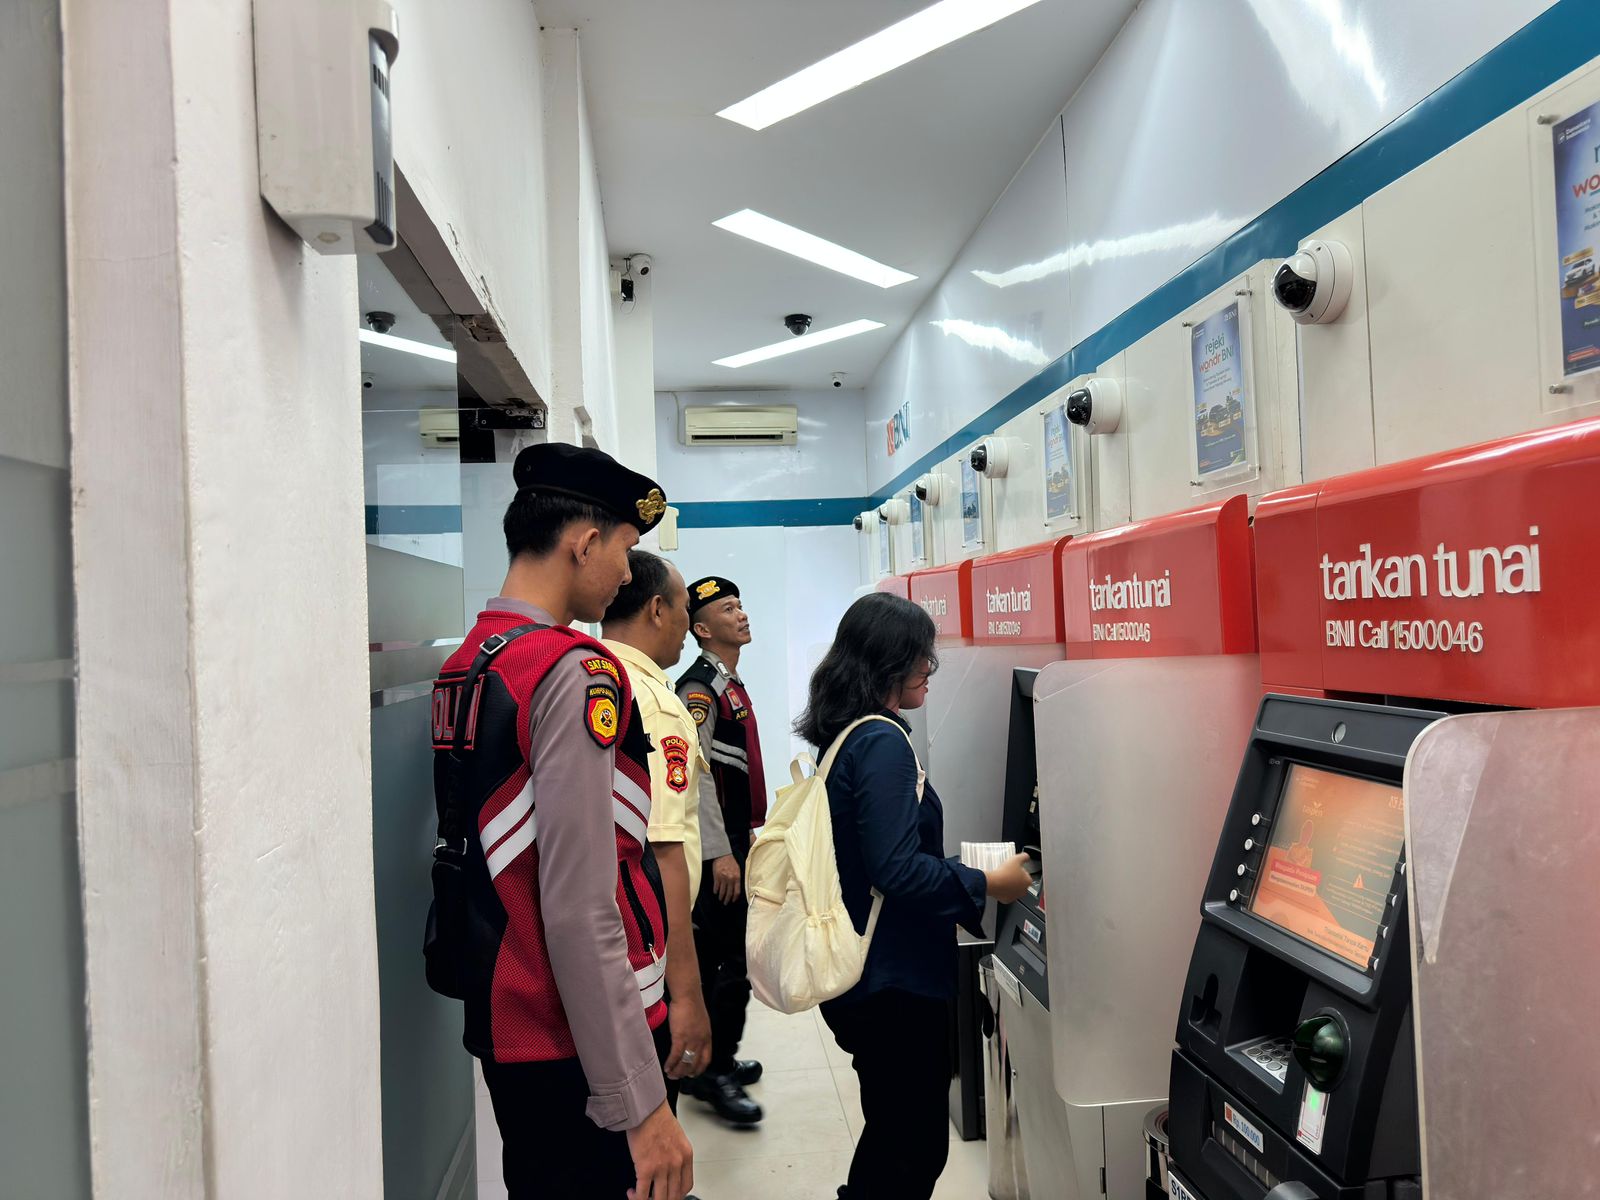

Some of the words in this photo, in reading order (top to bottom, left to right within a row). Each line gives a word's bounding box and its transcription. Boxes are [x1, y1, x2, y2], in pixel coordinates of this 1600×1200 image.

[1205, 332, 1225, 355] rejeki
[1199, 353, 1221, 373] wondr
[1319, 543, 1428, 600] tarikan
[1432, 525, 1542, 597] tunai
[1132, 569, 1171, 609] tunai
[1325, 619, 1356, 647] BNI
[1389, 619, 1484, 653] 1500046
[587, 659, 602, 671] SAT
